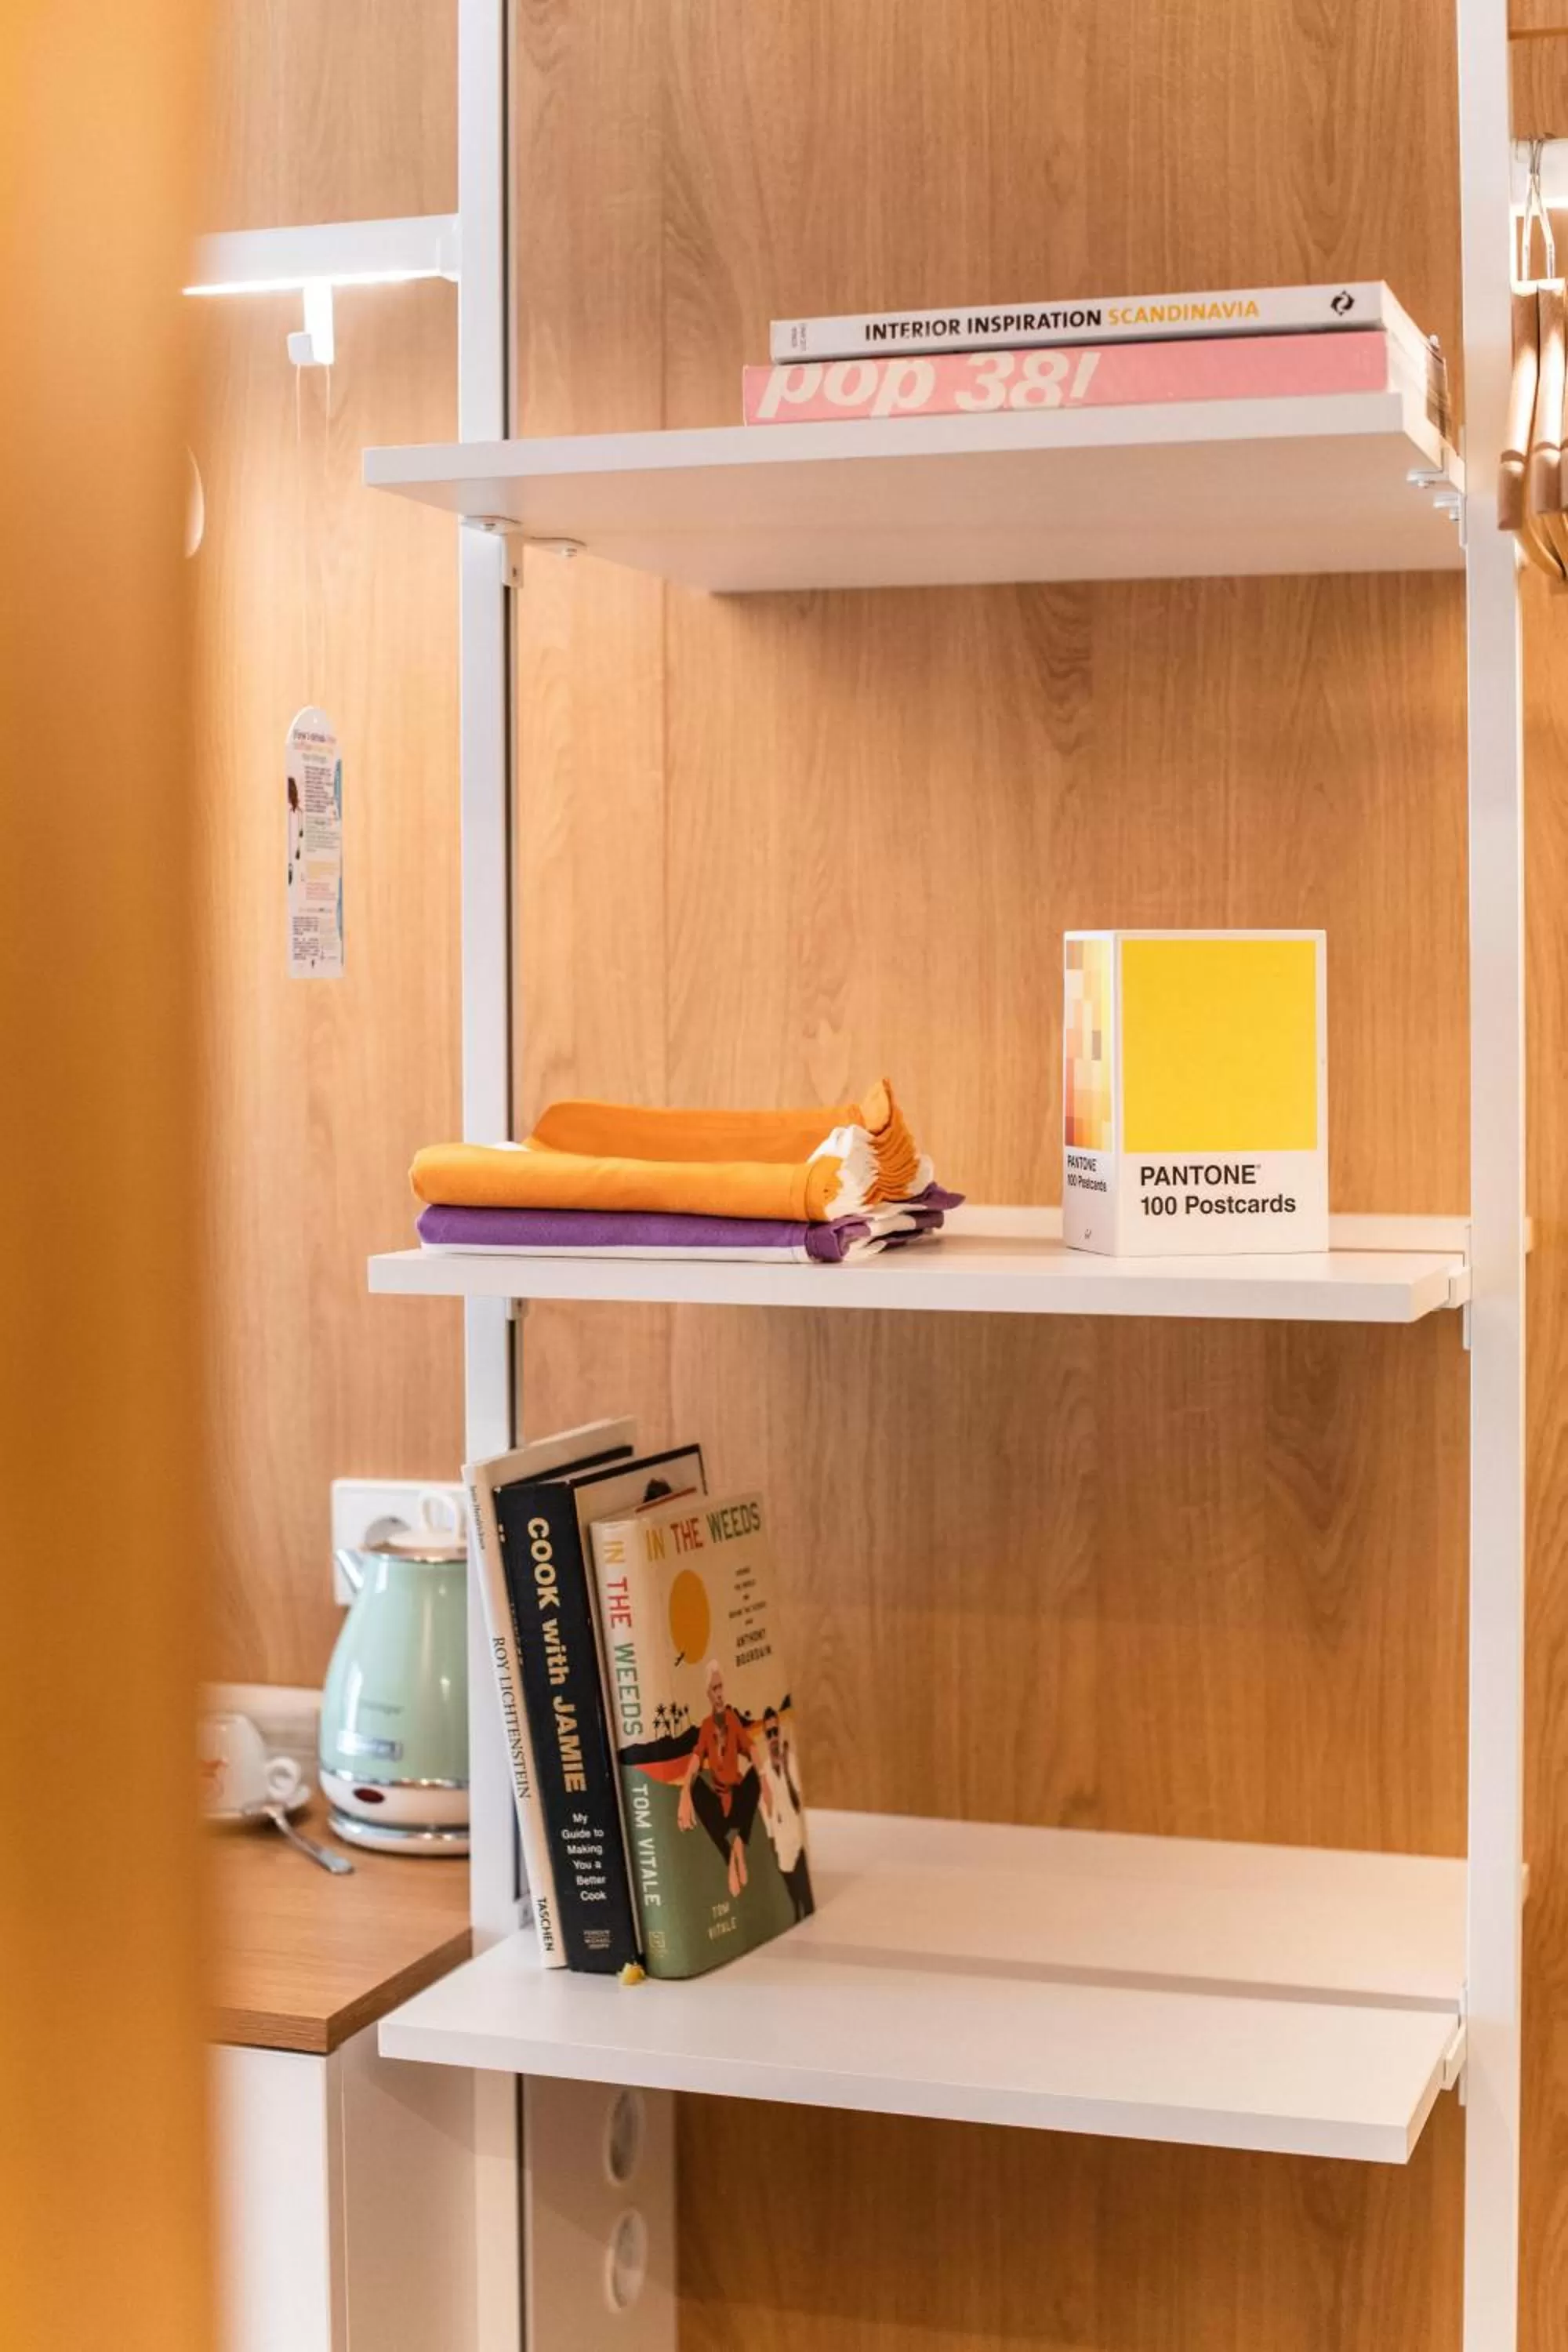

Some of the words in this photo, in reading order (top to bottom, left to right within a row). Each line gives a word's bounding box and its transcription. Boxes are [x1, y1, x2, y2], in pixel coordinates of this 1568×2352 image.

[865, 318, 960, 340] INTERIOR
[967, 309, 1102, 334] INSPIRATION
[1108, 299, 1260, 325] SCANDINAVIA
[755, 360, 936, 421] pop
[1067, 1154, 1097, 1172] PANTONE
[1067, 1174, 1077, 1186] 100
[1140, 1164, 1258, 1186] PANTONE
[1140, 1195, 1177, 1216] 100
[1185, 1193, 1297, 1215] Postcards
[645, 1528, 666, 1562] IN
[670, 1517, 704, 1555] THE
[706, 1501, 762, 1544] WEEDS
[527, 1516, 561, 1612] COOK
[603, 1540, 626, 1564] IN
[607, 1576, 633, 1630] THE
[492, 1636, 510, 1671] ROY
[541, 1617, 570, 1686] with
[614, 1642, 644, 1737] WEEDS
[498, 1675, 532, 1799] LICHTENSTEIN
[552, 1694, 587, 1794] JAMIE
[572, 1813, 589, 1825] My
[631, 1783, 653, 1830] TOM
[561, 1829, 591, 1839] Guide
[593, 1828, 604, 1837] to
[567, 1844, 603, 1856] Making
[573, 1860, 592, 1870] You
[594, 1860, 602, 1869] a
[576, 1875, 606, 1886] Better
[637, 1837, 662, 1907] VITALE
[579, 1890, 607, 1901] Cook
[712, 1901, 730, 1918] TOM
[536, 1896, 554, 1952] TASCHEN
